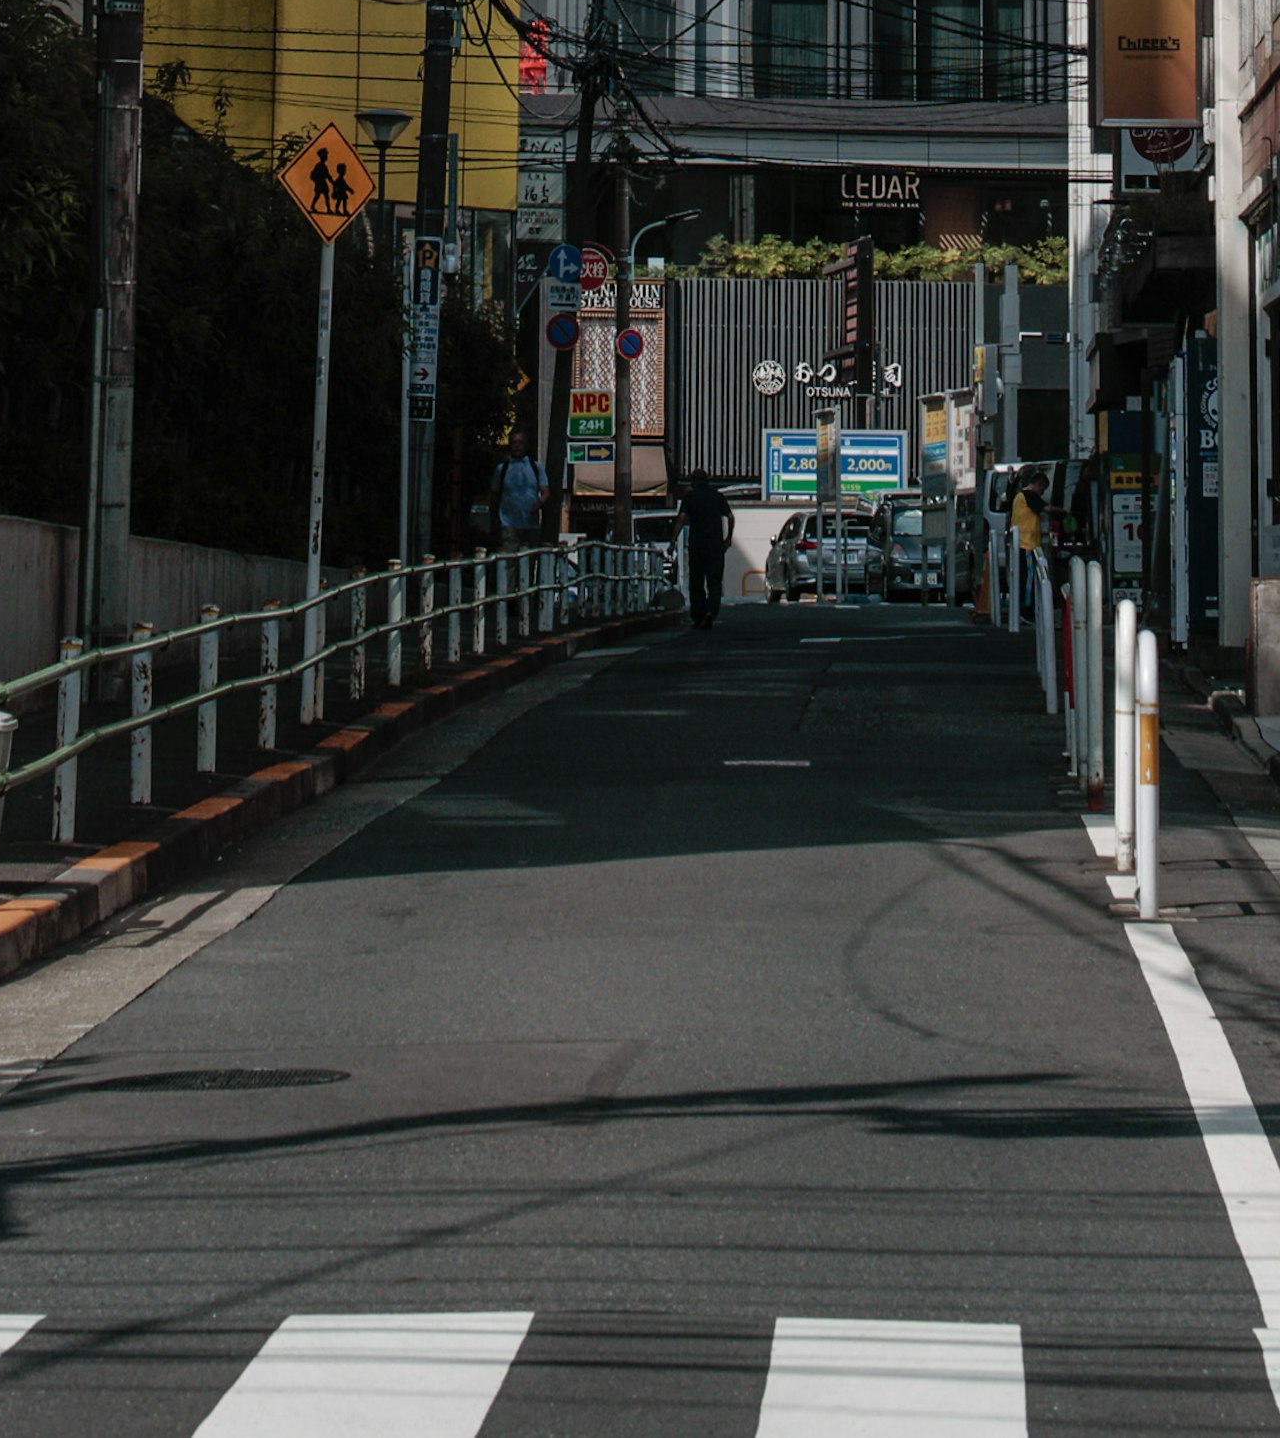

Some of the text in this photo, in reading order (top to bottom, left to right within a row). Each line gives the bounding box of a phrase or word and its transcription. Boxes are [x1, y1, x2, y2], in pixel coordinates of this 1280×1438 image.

[806, 386, 851, 398] OTSUNA
[572, 393, 610, 413] NPC
[578, 419, 605, 430] 24H
